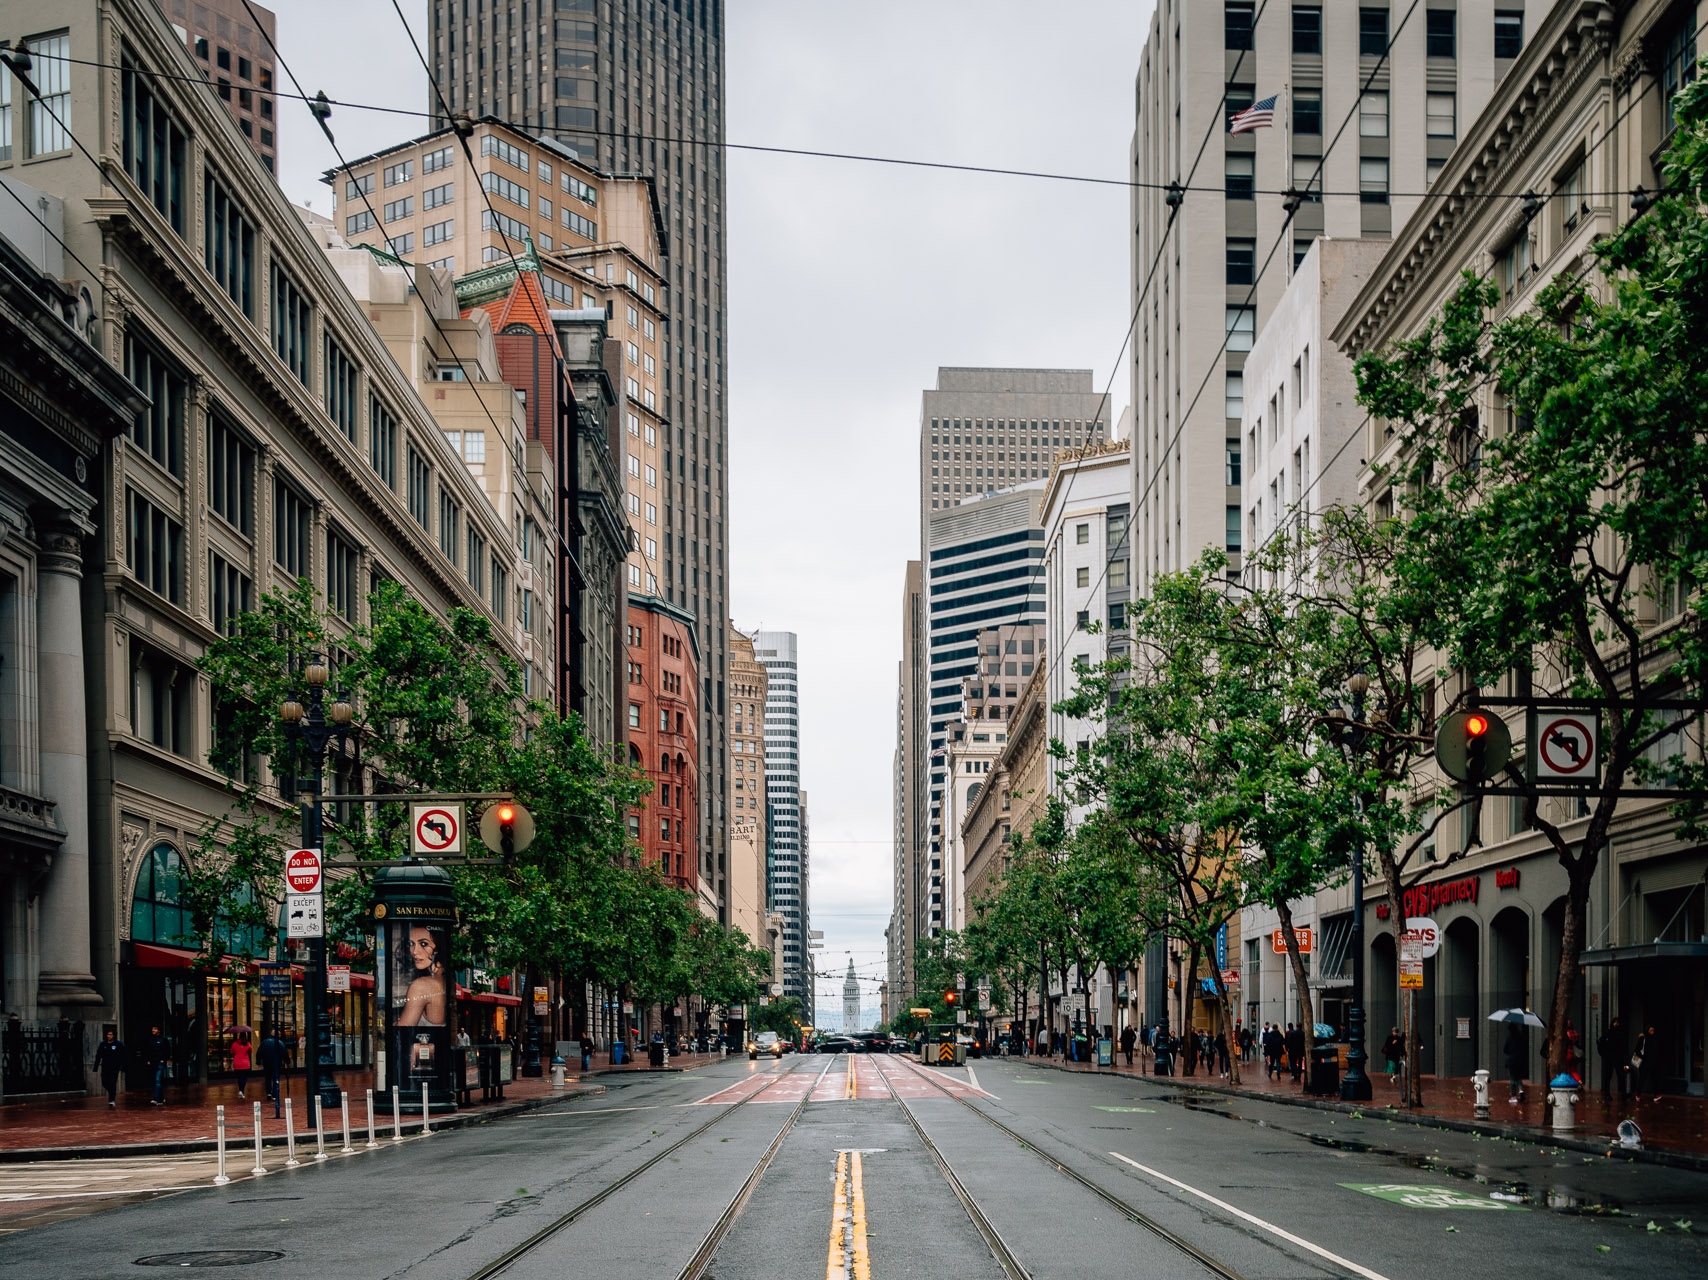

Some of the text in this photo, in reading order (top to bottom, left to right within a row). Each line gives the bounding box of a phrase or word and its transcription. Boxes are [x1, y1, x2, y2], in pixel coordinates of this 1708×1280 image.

[291, 859, 301, 867] DO
[294, 877, 314, 885] ENTER
[1495, 868, 1518, 888] Beauty
[1403, 876, 1479, 918] CVS/pharmacy
[1277, 931, 1308, 939] SER
